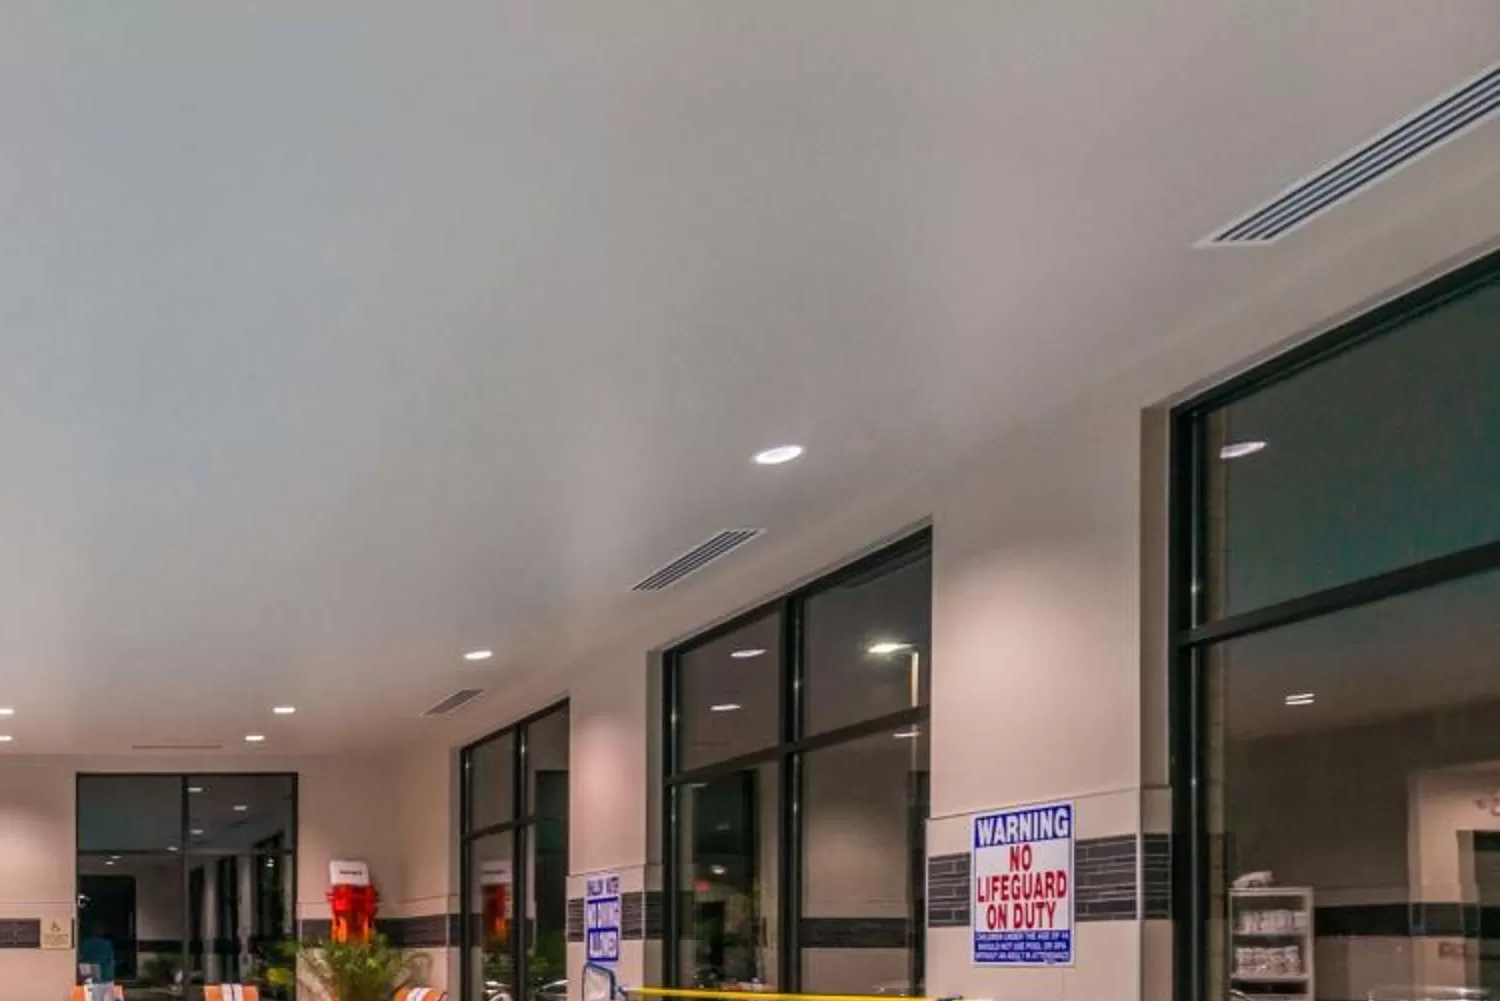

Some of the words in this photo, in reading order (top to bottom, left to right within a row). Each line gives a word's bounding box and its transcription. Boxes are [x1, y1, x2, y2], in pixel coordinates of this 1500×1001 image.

[977, 807, 1069, 845] WARNING
[1010, 844, 1032, 872] NO
[977, 870, 1066, 902] LIFEGUARD
[986, 904, 1007, 929] ON
[1013, 901, 1056, 929] DUTY
